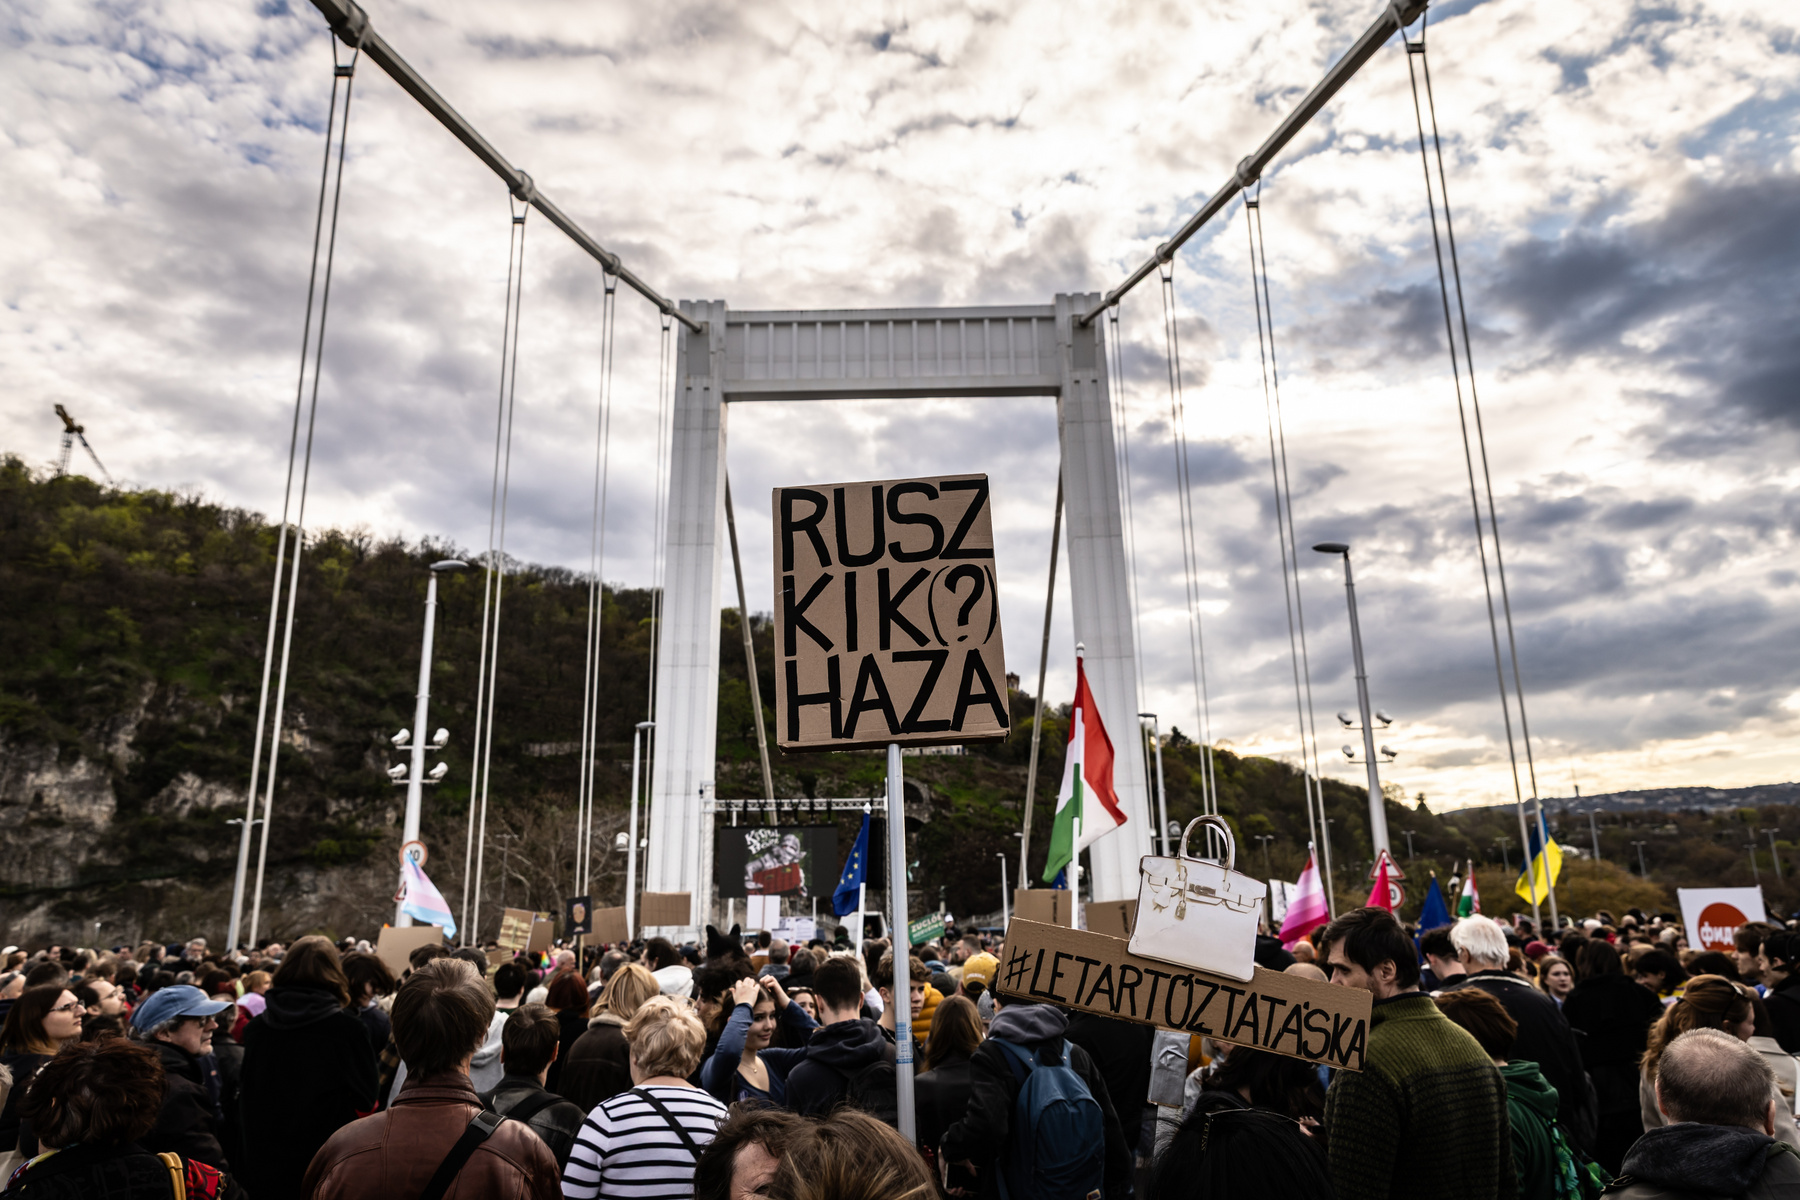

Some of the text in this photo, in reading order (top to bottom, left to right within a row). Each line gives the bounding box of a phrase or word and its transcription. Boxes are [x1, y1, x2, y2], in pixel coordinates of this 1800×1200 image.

[781, 480, 993, 571] RUSZ
[783, 564, 997, 656] KIK(?)
[785, 648, 1010, 741] HAZA
[1003, 945, 1366, 1070] #LETARTÓZTATÁSKA
